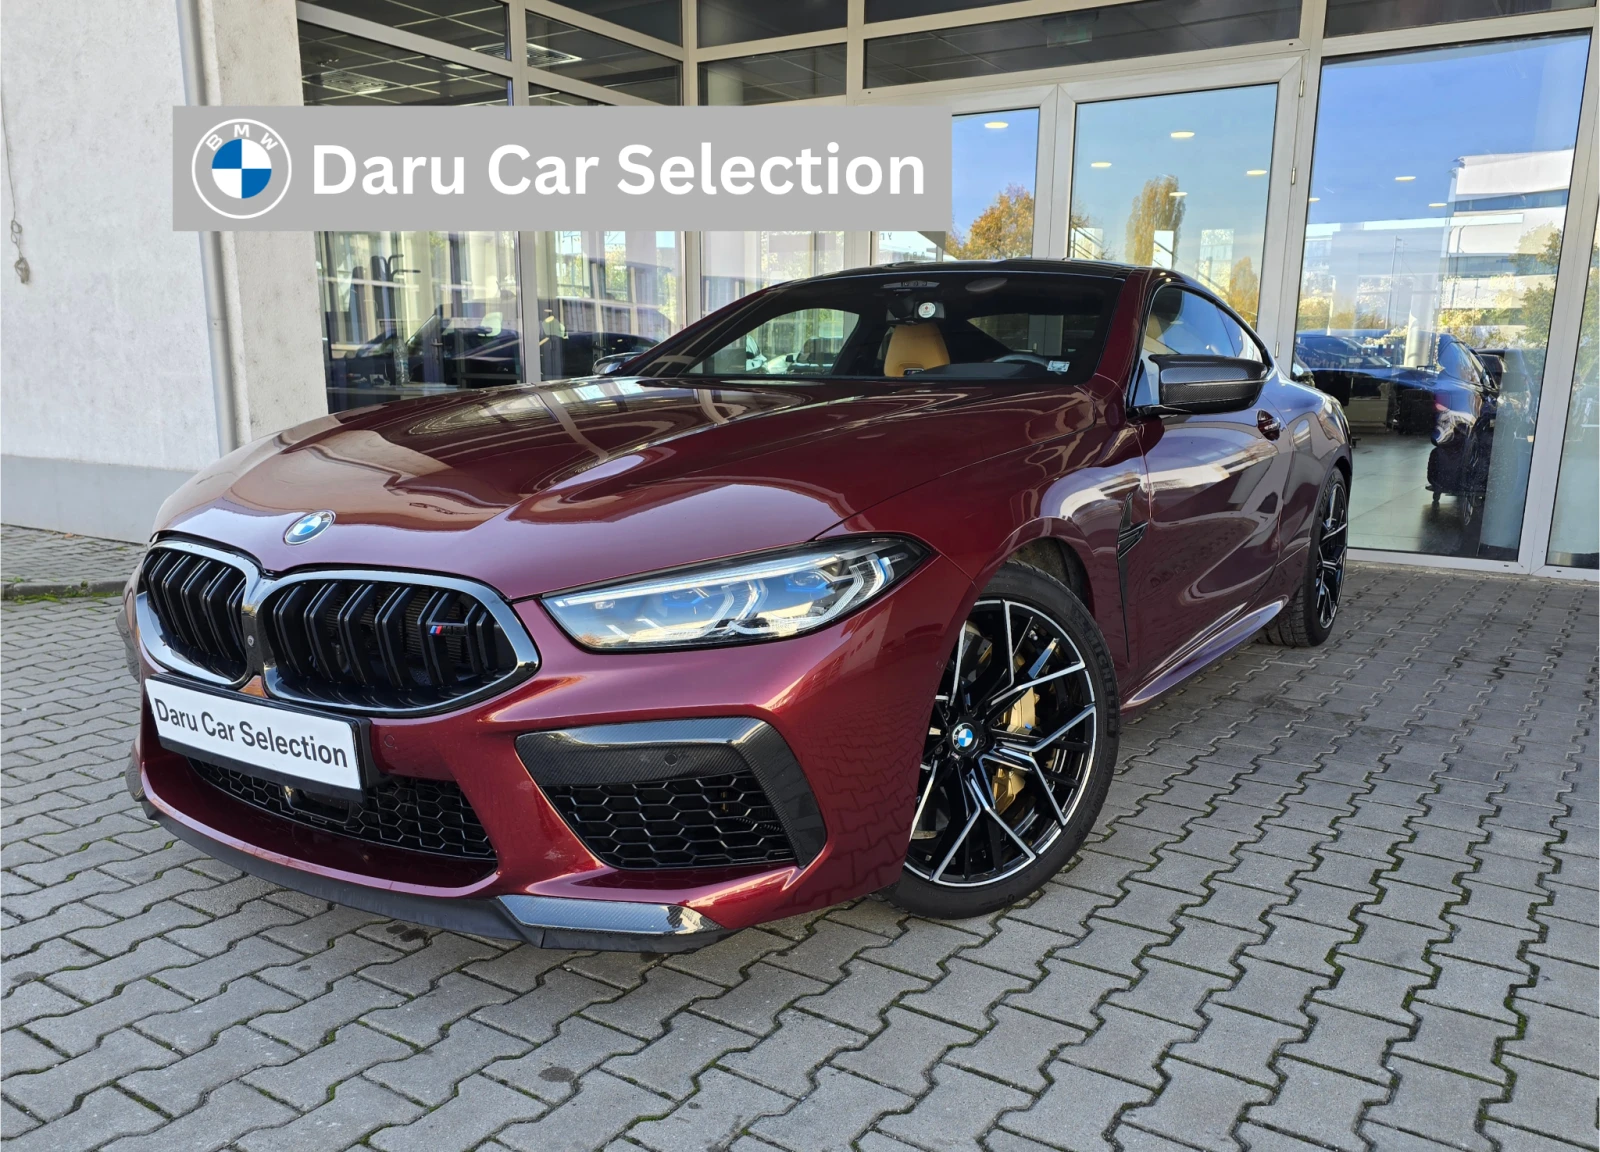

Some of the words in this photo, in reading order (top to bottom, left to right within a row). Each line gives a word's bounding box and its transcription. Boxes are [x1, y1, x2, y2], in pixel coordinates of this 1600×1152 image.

[153, 697, 199, 732] Daru
[201, 711, 235, 742] Car
[238, 720, 348, 768] Selection
